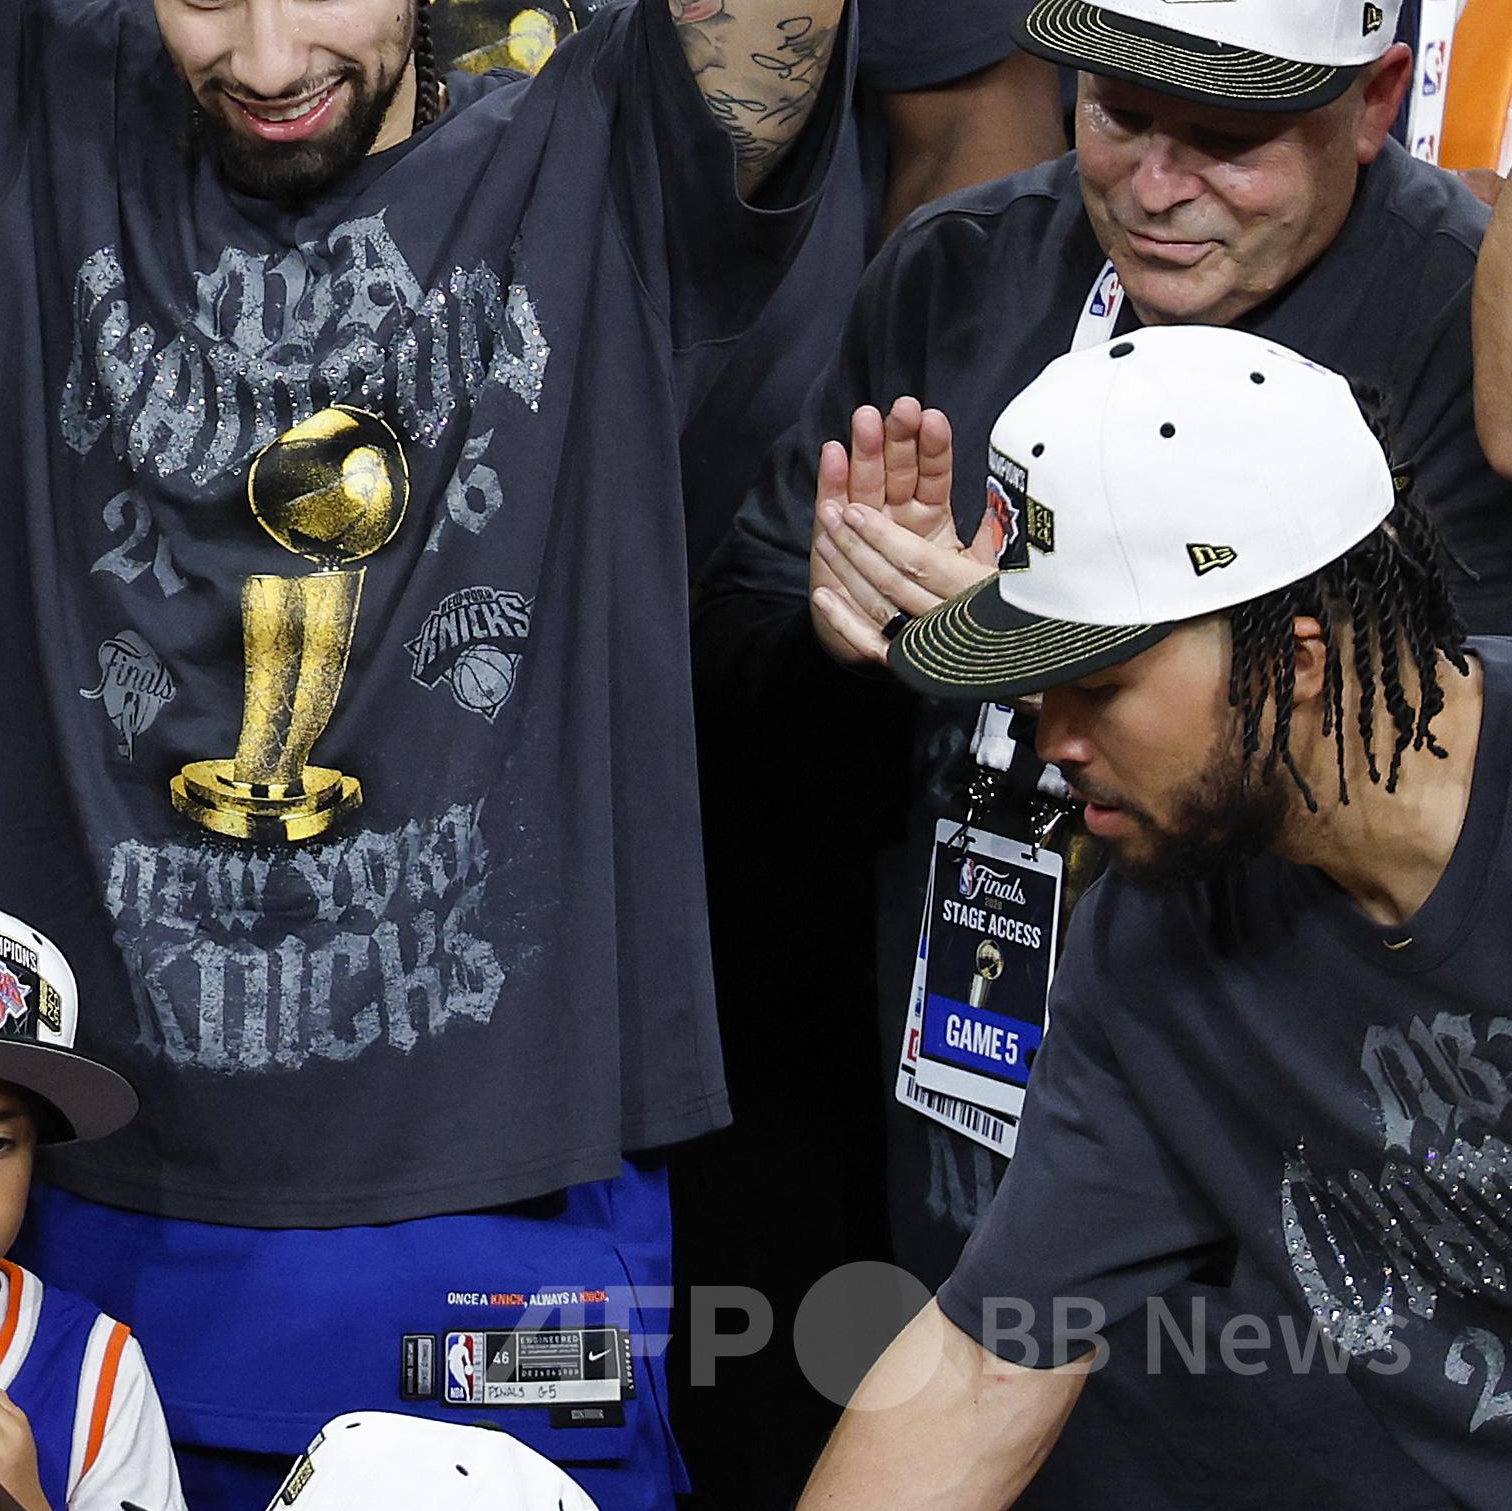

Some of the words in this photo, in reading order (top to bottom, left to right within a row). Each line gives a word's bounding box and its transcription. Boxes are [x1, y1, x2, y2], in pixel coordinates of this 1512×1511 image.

[415, 597, 532, 678] KNICKS
[965, 864, 1027, 906] Finals
[942, 899, 987, 932] STAGE
[987, 914, 1042, 949] ACCESS
[945, 1013, 1003, 1060] GAME
[1003, 1031, 1019, 1066] 5
[447, 1292, 480, 1306] ONCE
[480, 1293, 489, 1306] A
[490, 1293, 529, 1309] KNICK,
[529, 1291, 570, 1306] ALWAYS
[570, 1292, 579, 1304] A
[492, 1351, 510, 1365] 46
